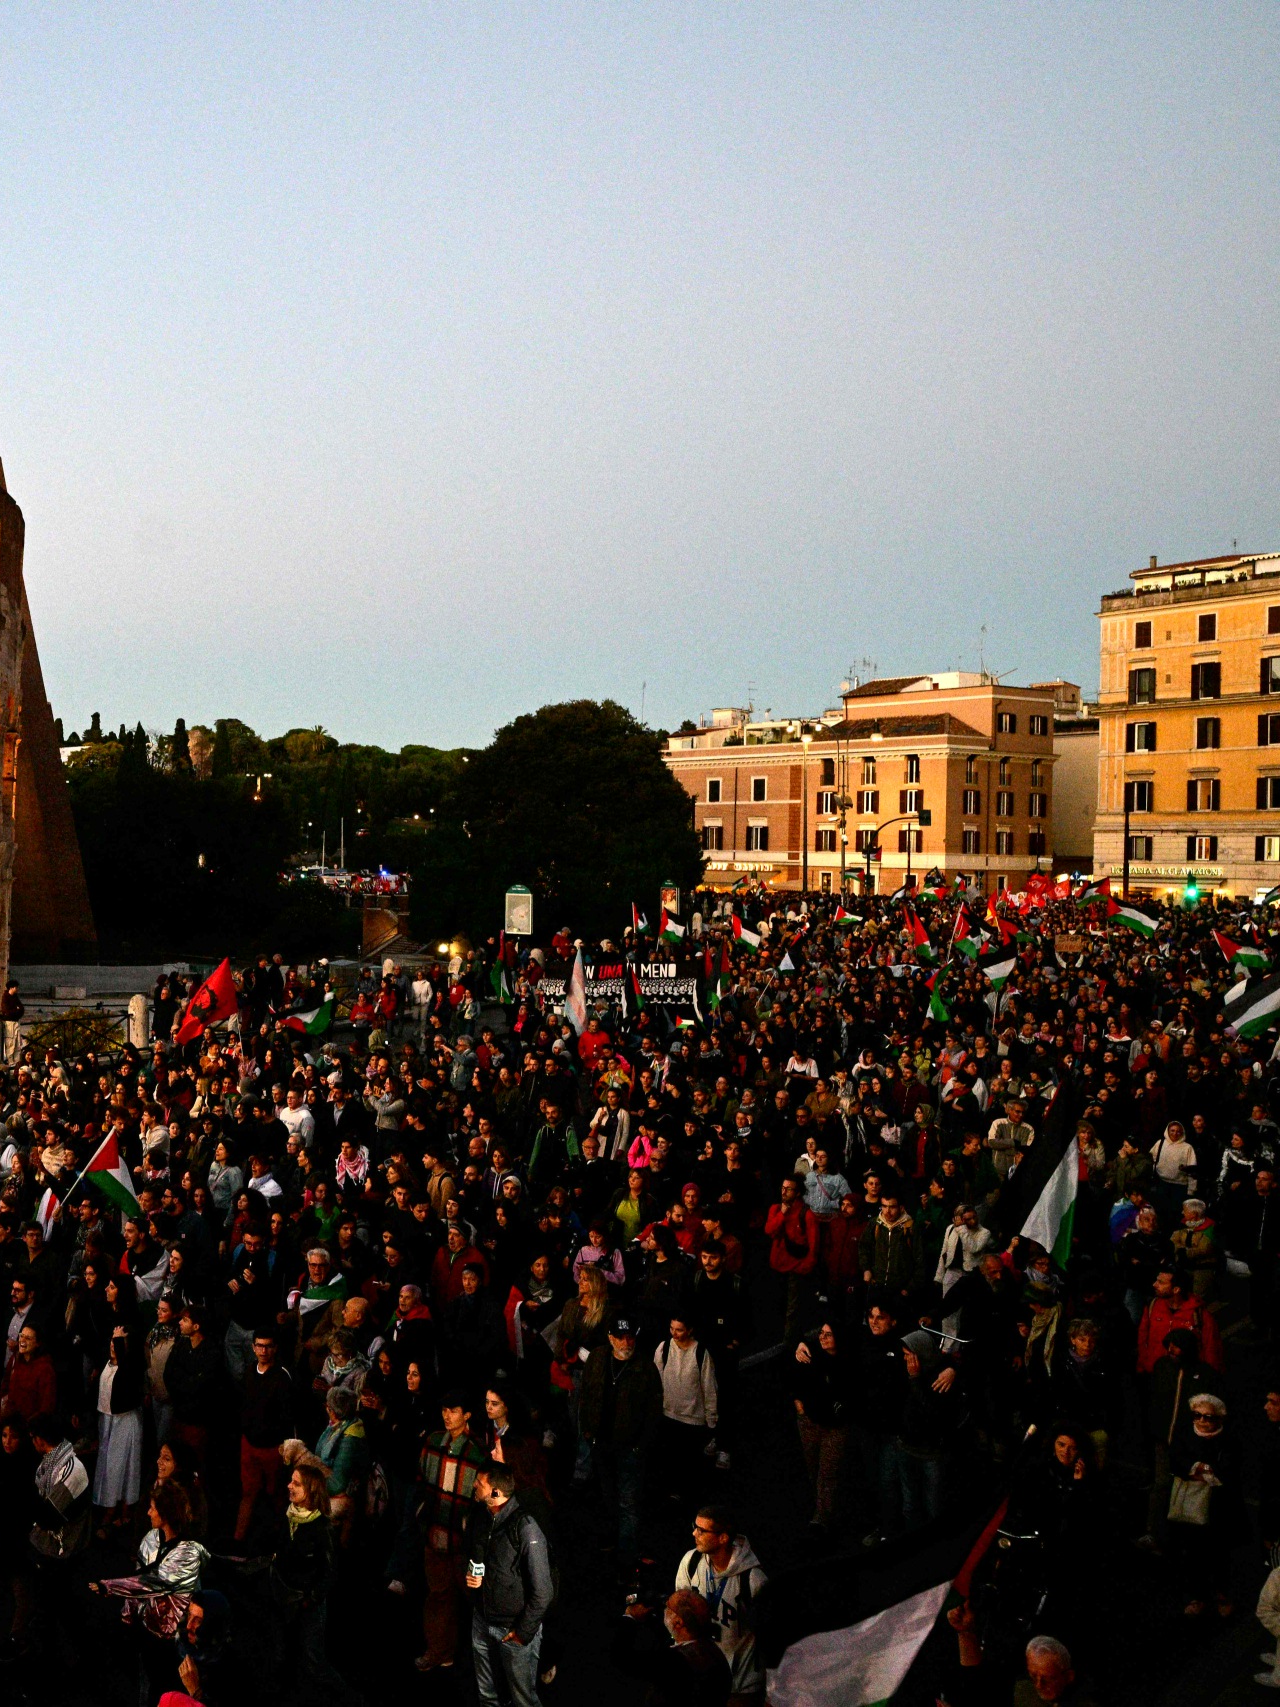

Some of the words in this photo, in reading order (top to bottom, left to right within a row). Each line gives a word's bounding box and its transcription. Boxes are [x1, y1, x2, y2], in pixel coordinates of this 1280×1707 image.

[1111, 865, 1152, 875] HOARIA
[598, 964, 624, 980] UNA
[640, 963, 677, 978] MENO
